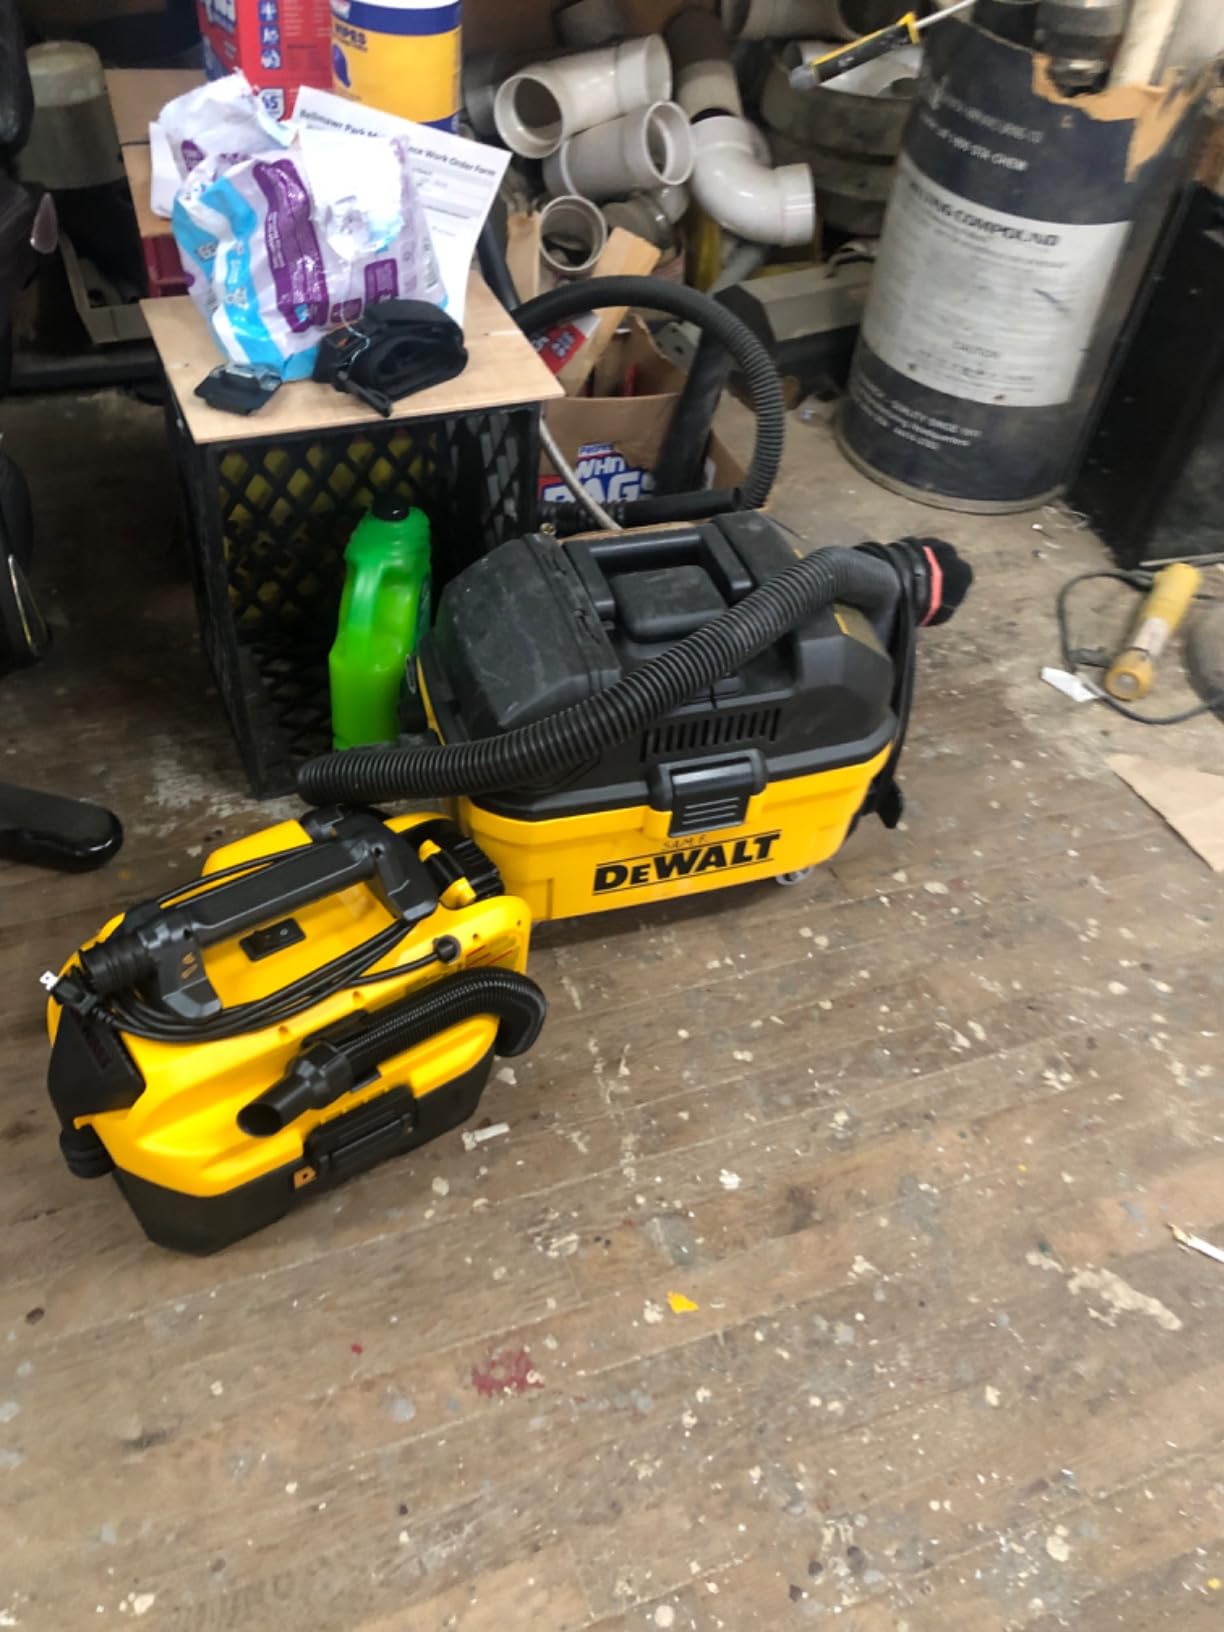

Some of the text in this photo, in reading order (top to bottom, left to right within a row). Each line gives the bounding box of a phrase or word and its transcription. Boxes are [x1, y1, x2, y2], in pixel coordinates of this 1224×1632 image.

[344, 122, 367, 136] Park
[425, 150, 449, 164] Work
[449, 157, 475, 172] Order
[474, 164, 497, 178] Form
[952, 208, 1060, 247] COMPOUND
